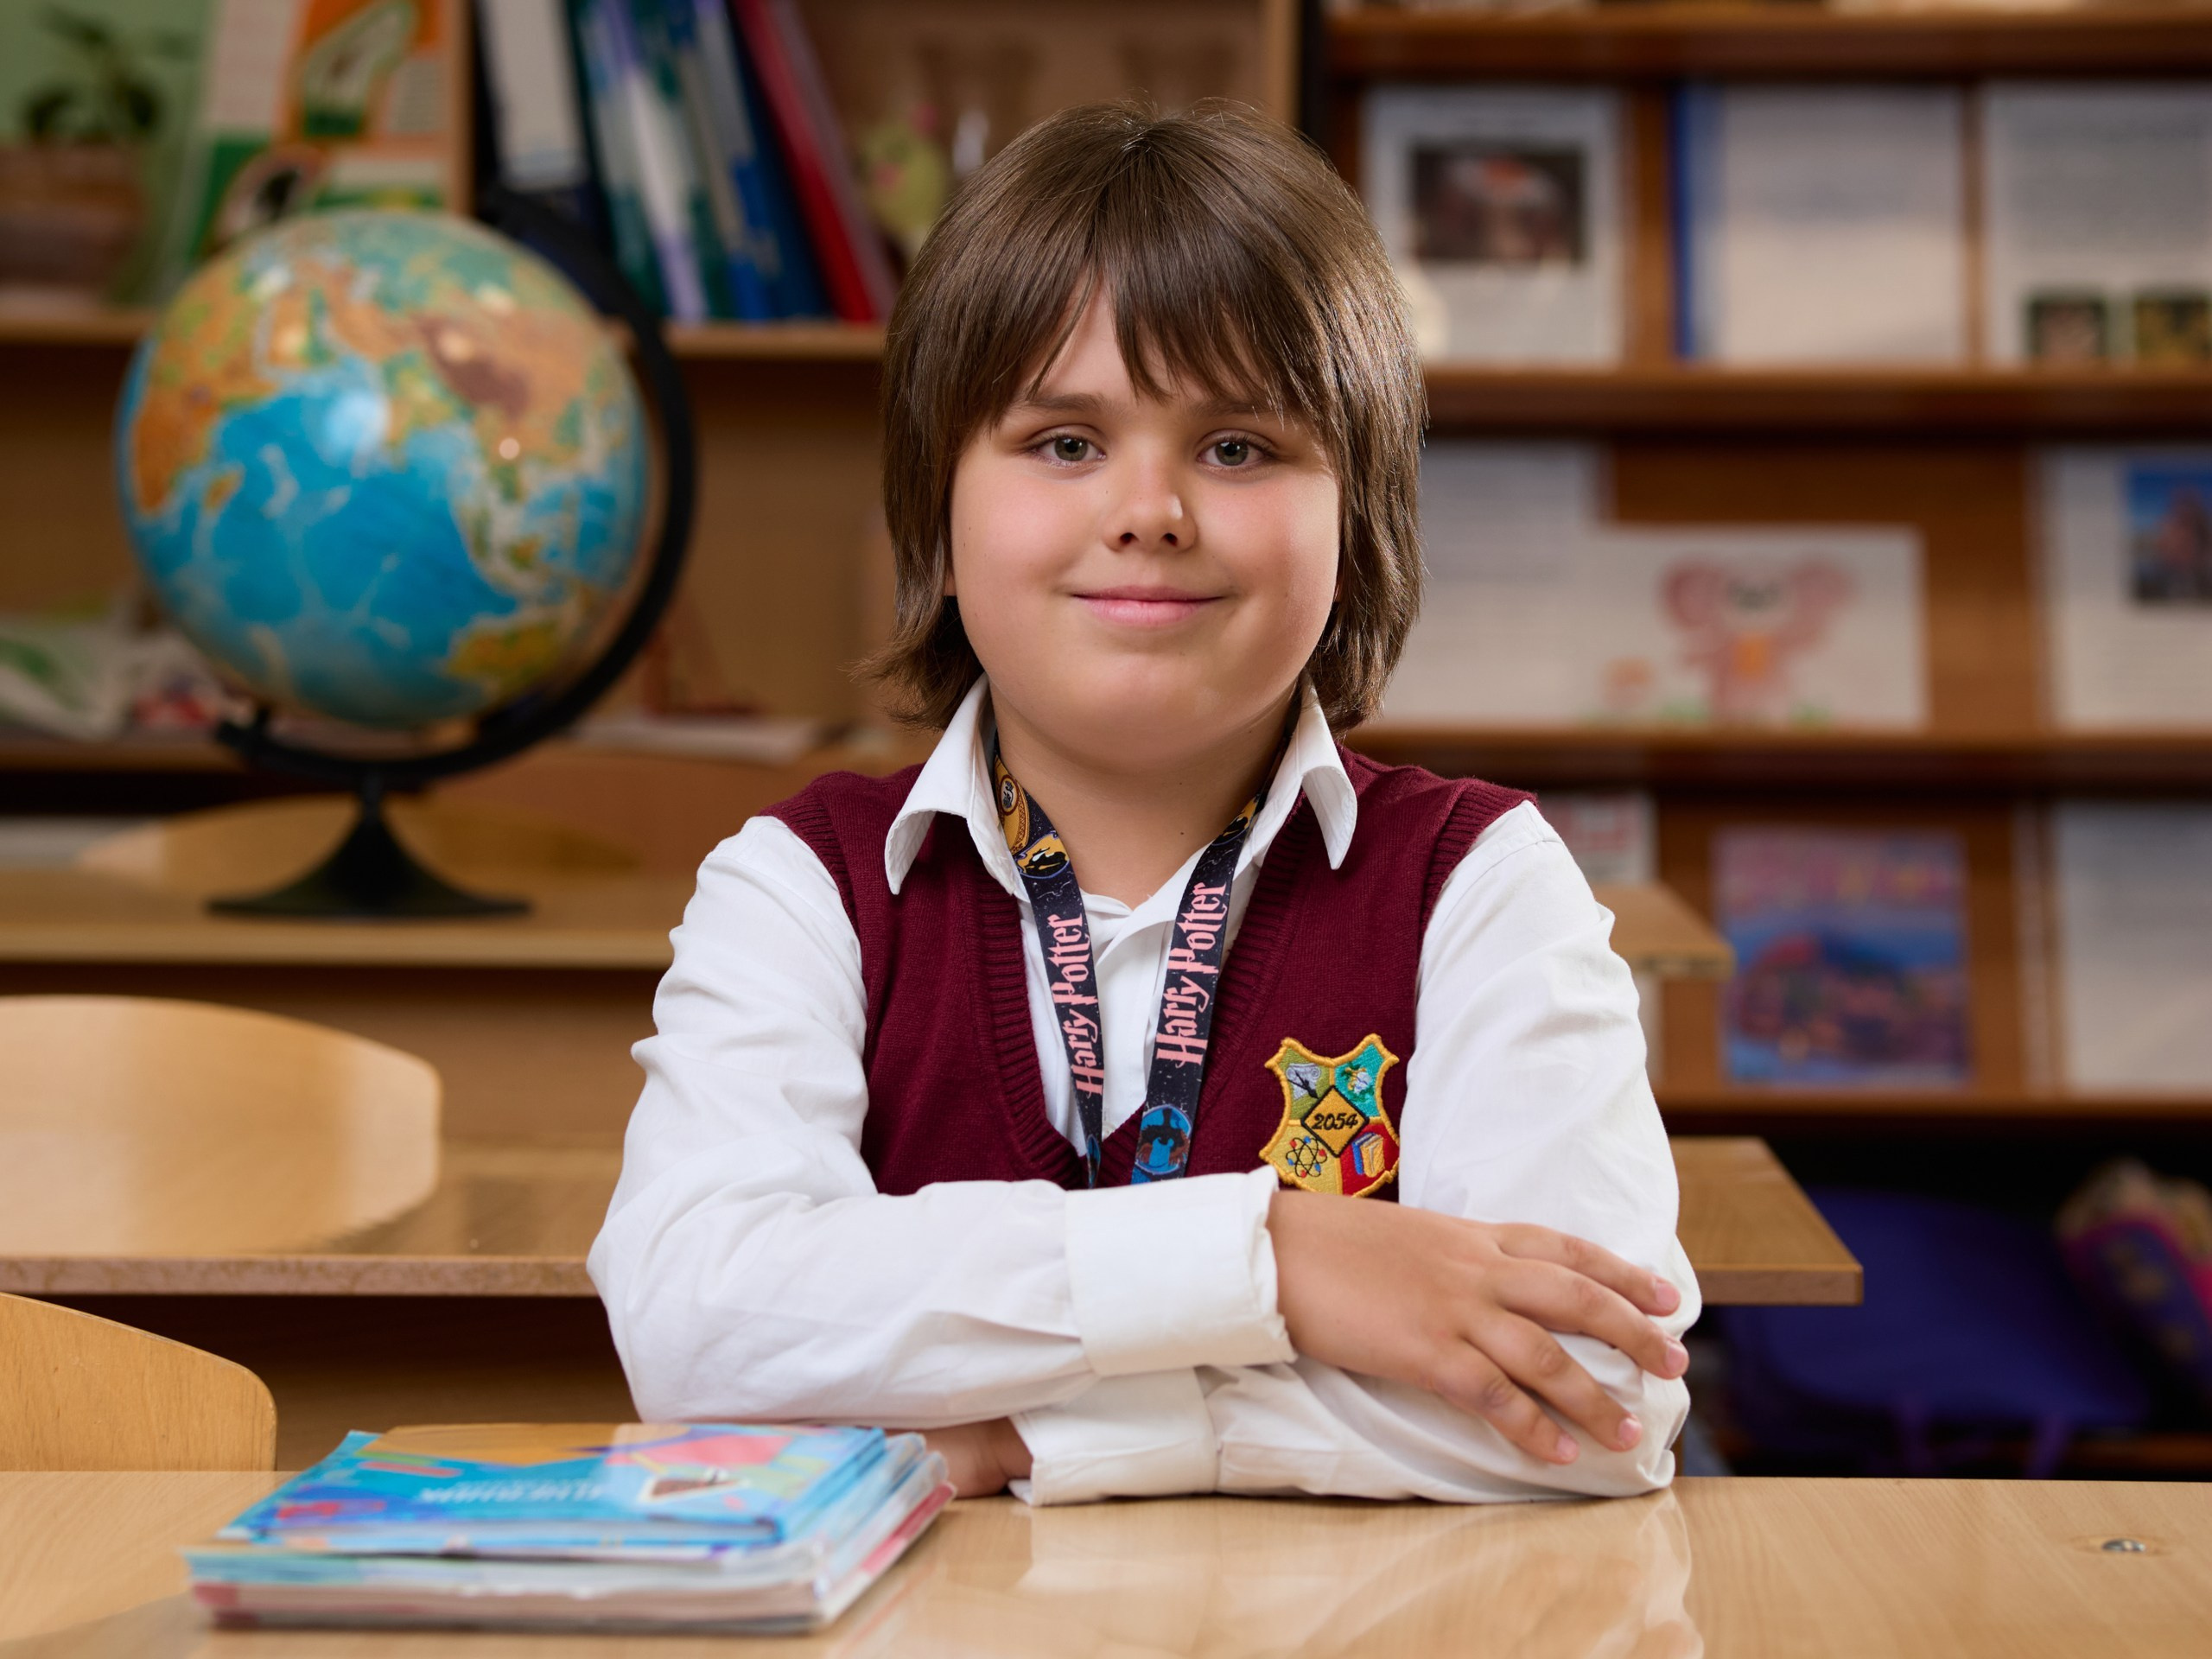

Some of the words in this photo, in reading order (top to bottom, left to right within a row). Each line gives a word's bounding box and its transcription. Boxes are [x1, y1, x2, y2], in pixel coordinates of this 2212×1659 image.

[1048, 913, 1098, 1007] Potter
[1166, 881, 1227, 975] Potter
[1062, 1009, 1104, 1098] Harry
[1155, 976, 1210, 1068] Harry
[1312, 1113, 1358, 1130] 2054
